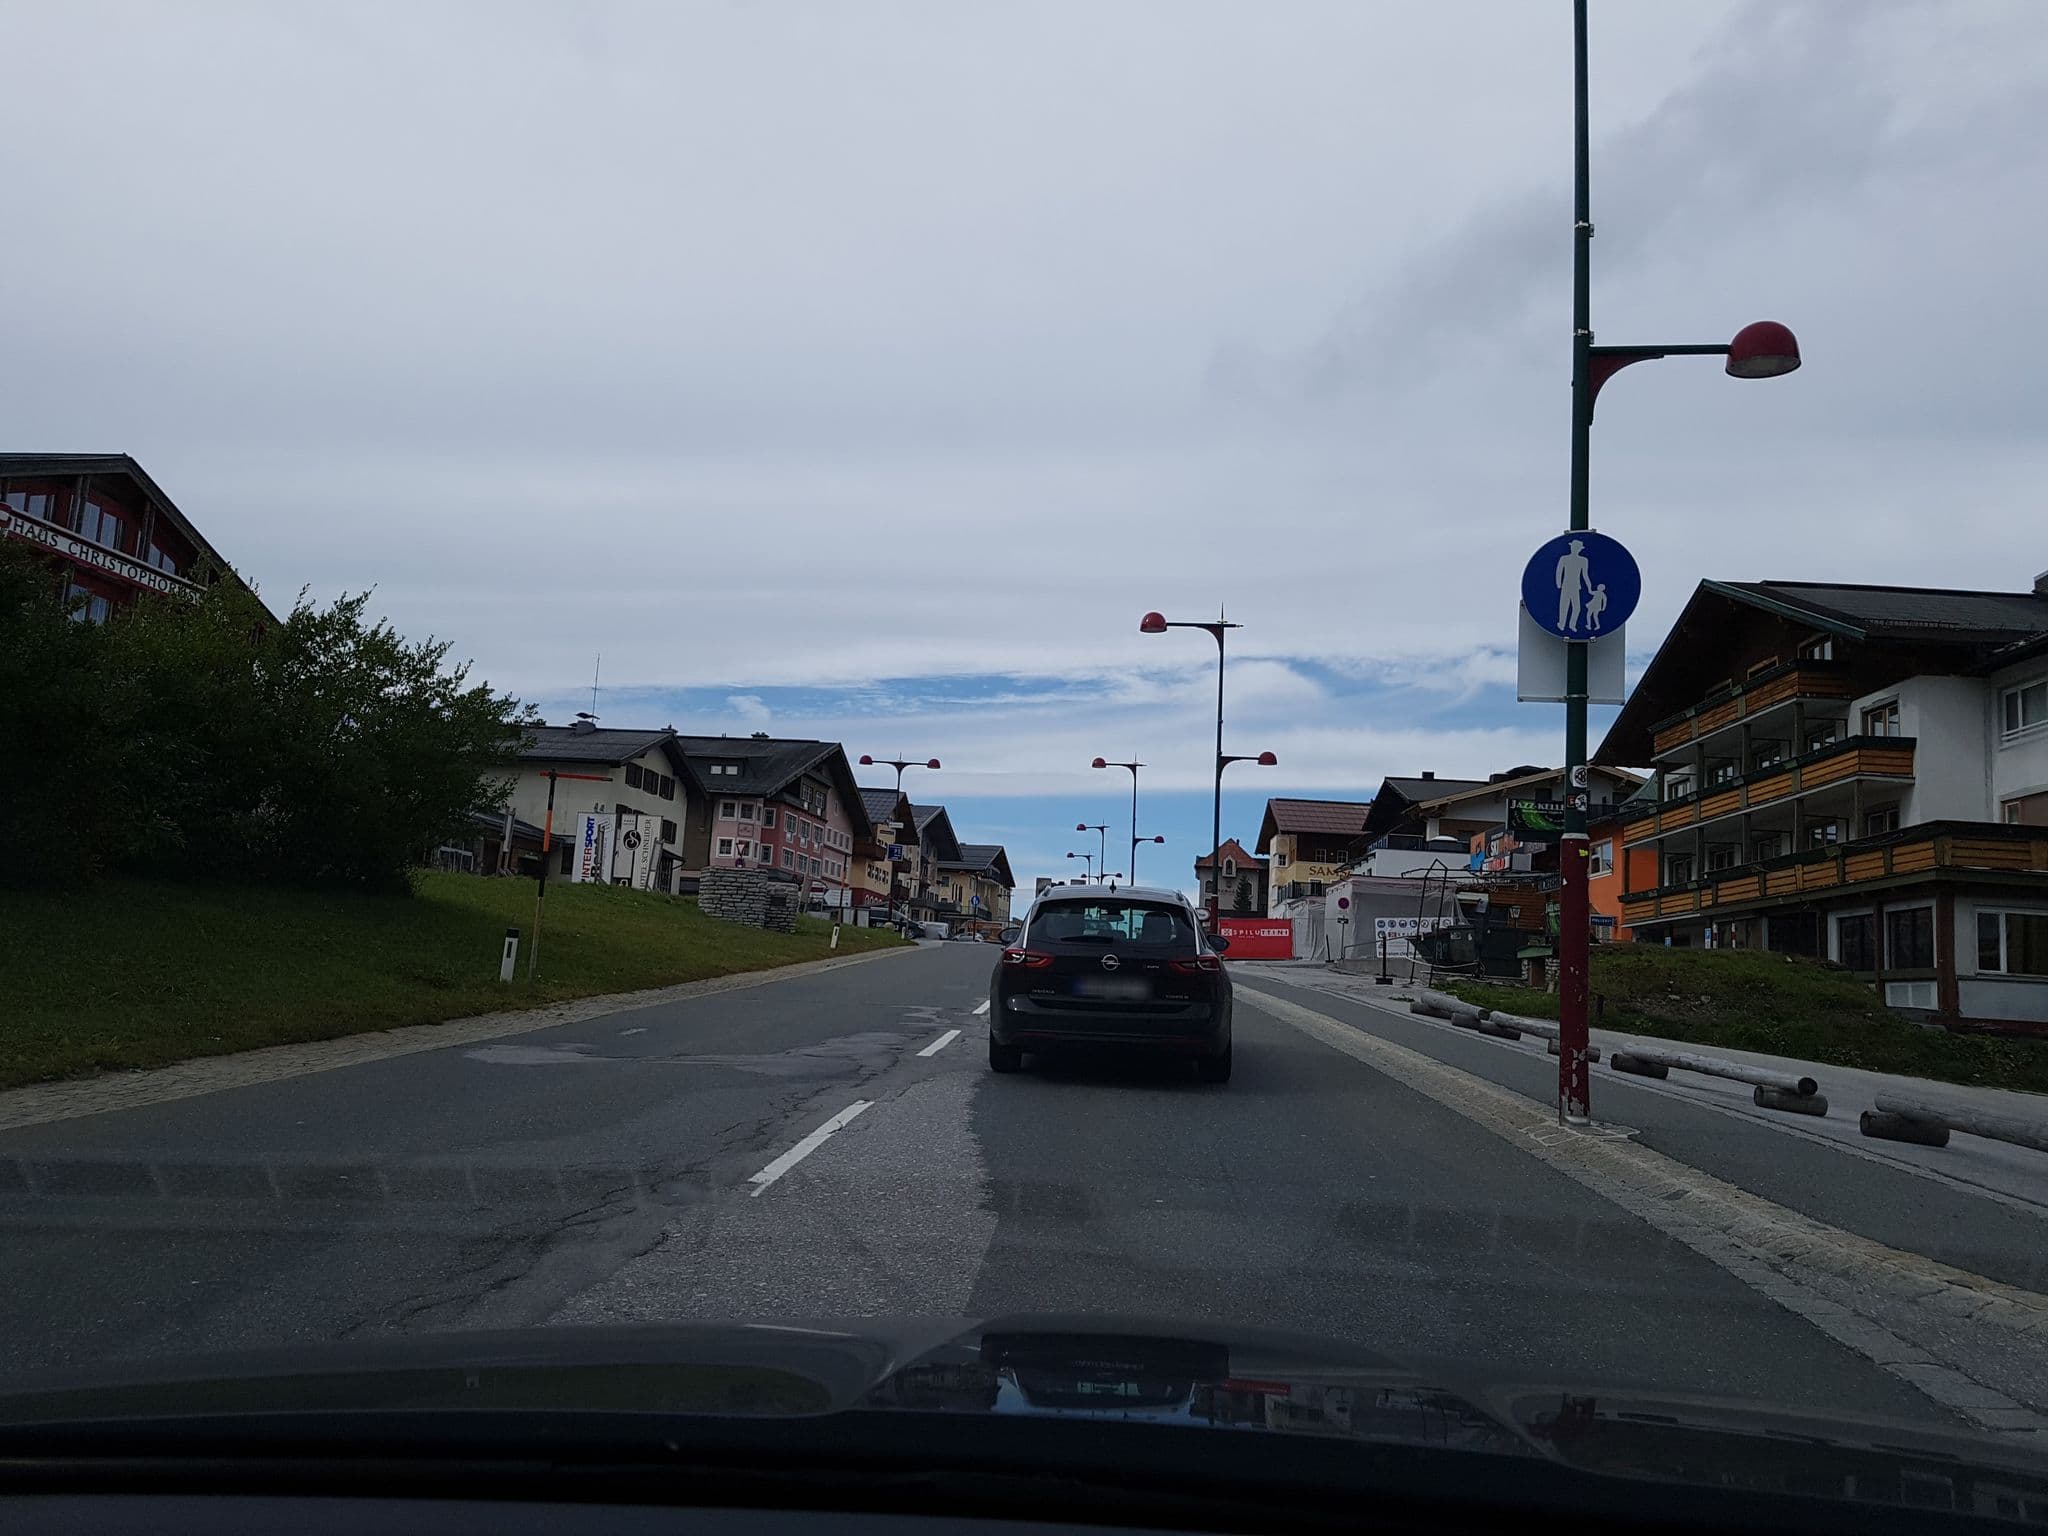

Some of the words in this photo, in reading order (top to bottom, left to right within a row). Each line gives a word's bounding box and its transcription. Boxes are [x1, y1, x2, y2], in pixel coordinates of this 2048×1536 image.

[13, 518, 59, 548] HAUS
[581, 816, 595, 879] INTERSPORT
[642, 819, 653, 863] SCHNEIDER
